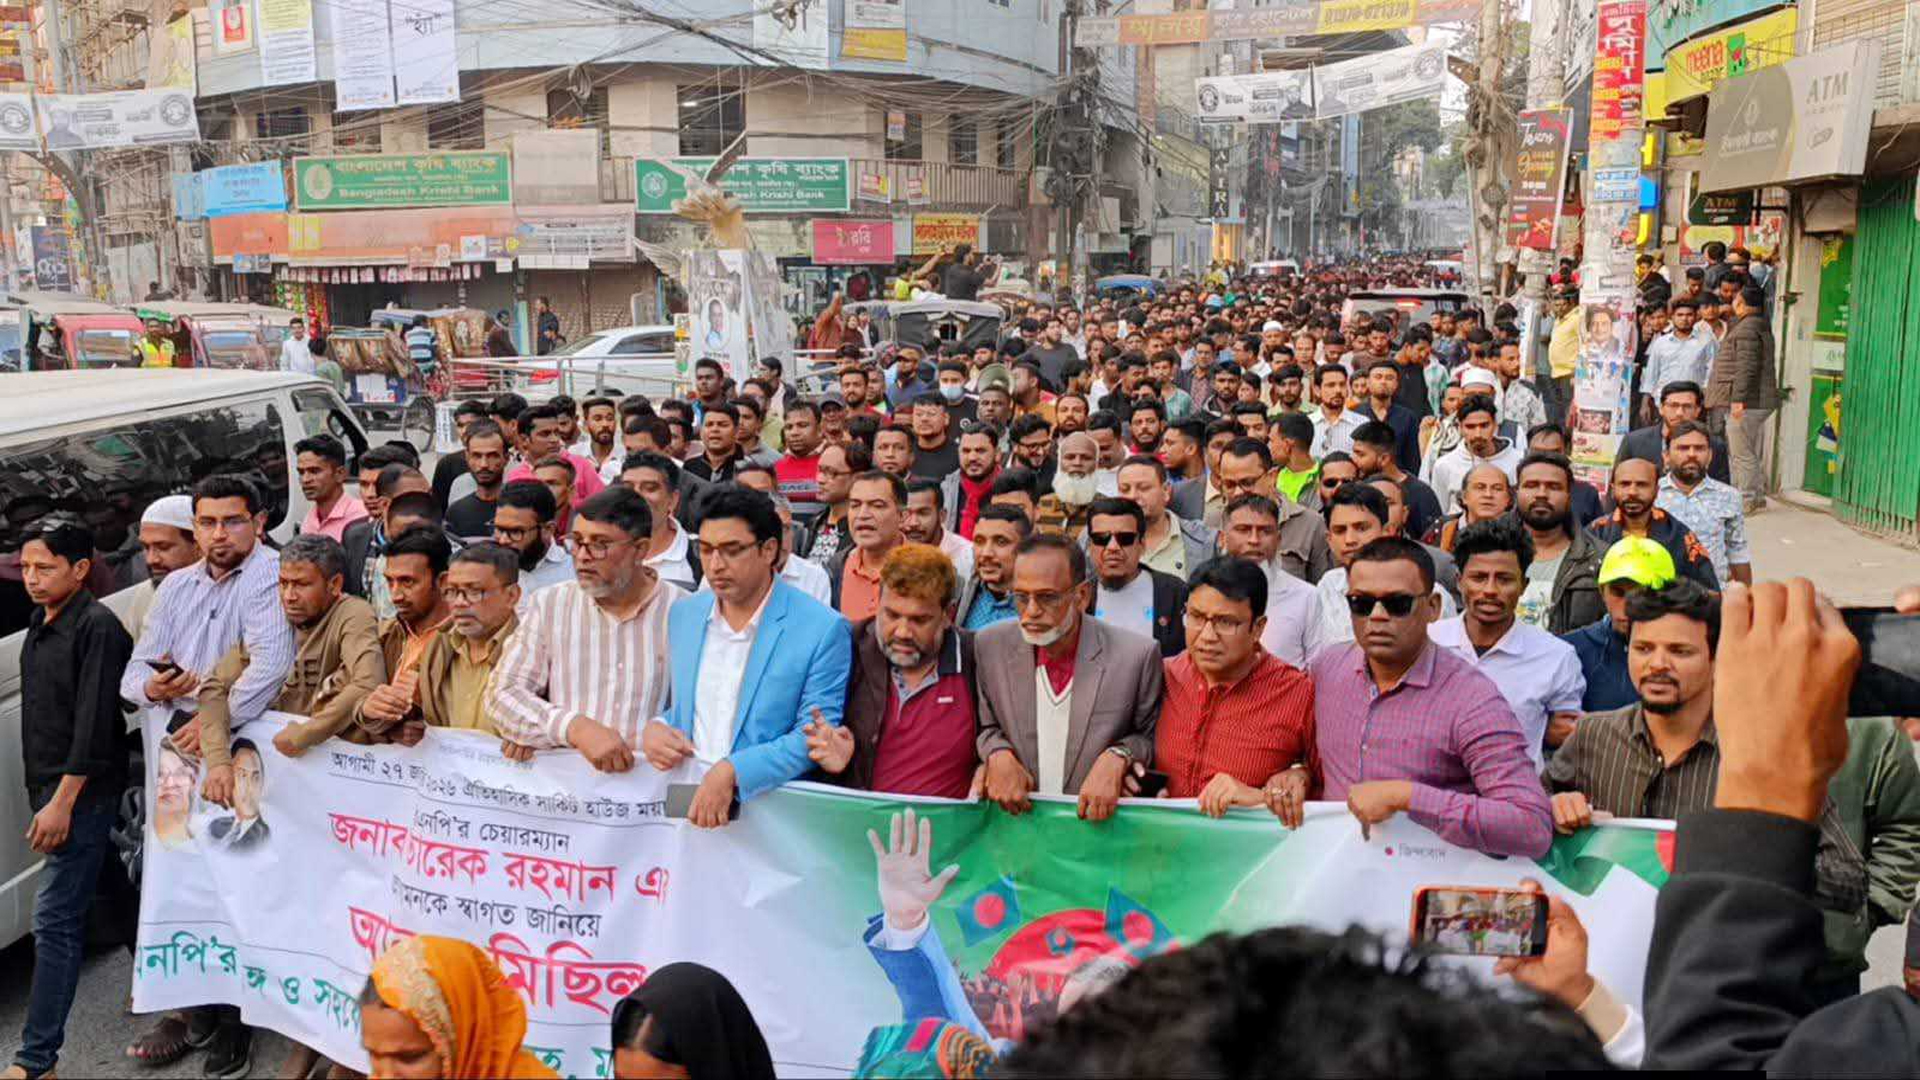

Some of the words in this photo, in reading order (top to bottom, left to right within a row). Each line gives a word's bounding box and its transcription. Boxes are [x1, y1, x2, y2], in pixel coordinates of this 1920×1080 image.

[1685, 39, 1724, 76] meena
[1805, 70, 1850, 105] ATM
[413, 155, 447, 175] কৃষি
[451, 157, 498, 172] ব্যাংক
[755, 159, 788, 180] কৃষি
[794, 162, 840, 175] ব্যাংক
[339, 187, 416, 199] Bangladesh
[421, 185, 460, 197] Krishi
[464, 184, 499, 195] Bank
[760, 189, 794, 200] Krishi
[796, 189, 825, 200] Bank
[1704, 197, 1739, 209] ATM
[331, 751, 377, 775] আগামী
[380, 761, 403, 780] ২৭
[584, 796, 631, 819] হাউজ
[479, 823, 570, 853] চেয়ারম্যান
[502, 852, 617, 904] রহমান
[456, 897, 518, 925] স্বাগত
[526, 904, 602, 938] জানিয়ে
[484, 931, 648, 1015] মিছিল
[278, 976, 300, 1005] ও
